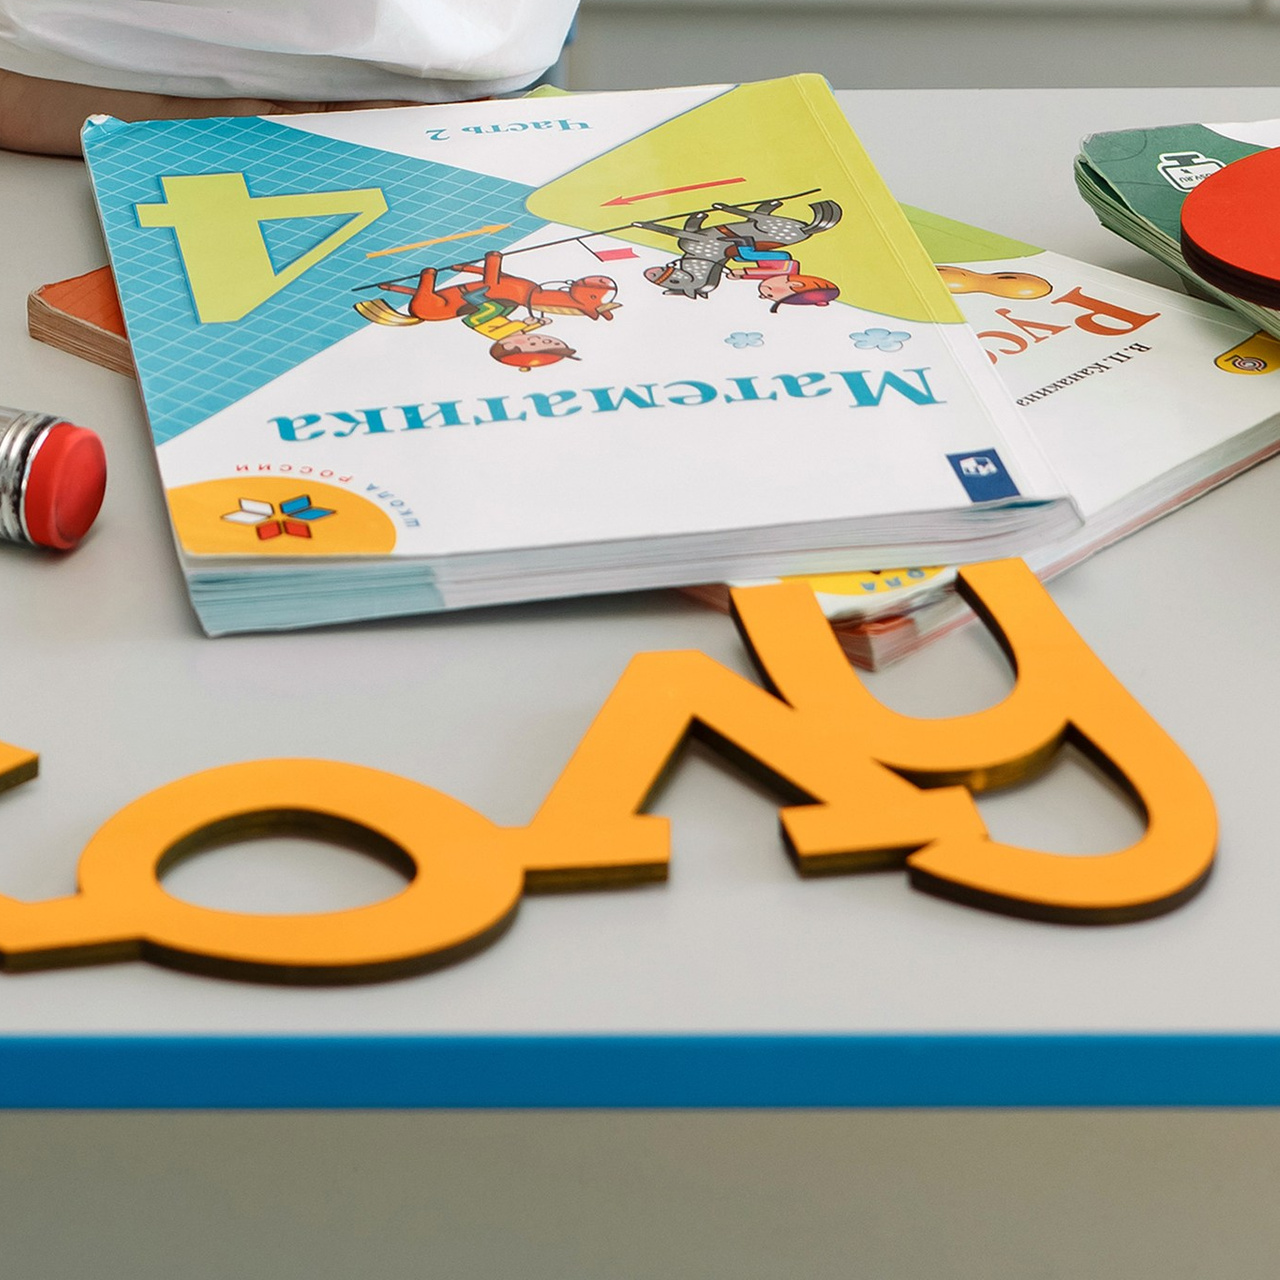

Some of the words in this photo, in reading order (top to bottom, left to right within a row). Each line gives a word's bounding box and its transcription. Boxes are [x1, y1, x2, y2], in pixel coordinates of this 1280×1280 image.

[425, 128, 451, 141] 2
[461, 118, 593, 134] Часть
[132, 172, 390, 325] 4
[976, 286, 1162, 365] Рус
[267, 366, 947, 442] Математика
[1015, 361, 1113, 407] Канакина
[235, 463, 354, 483] РОССИИ
[365, 482, 421, 528] ШКОЛА
